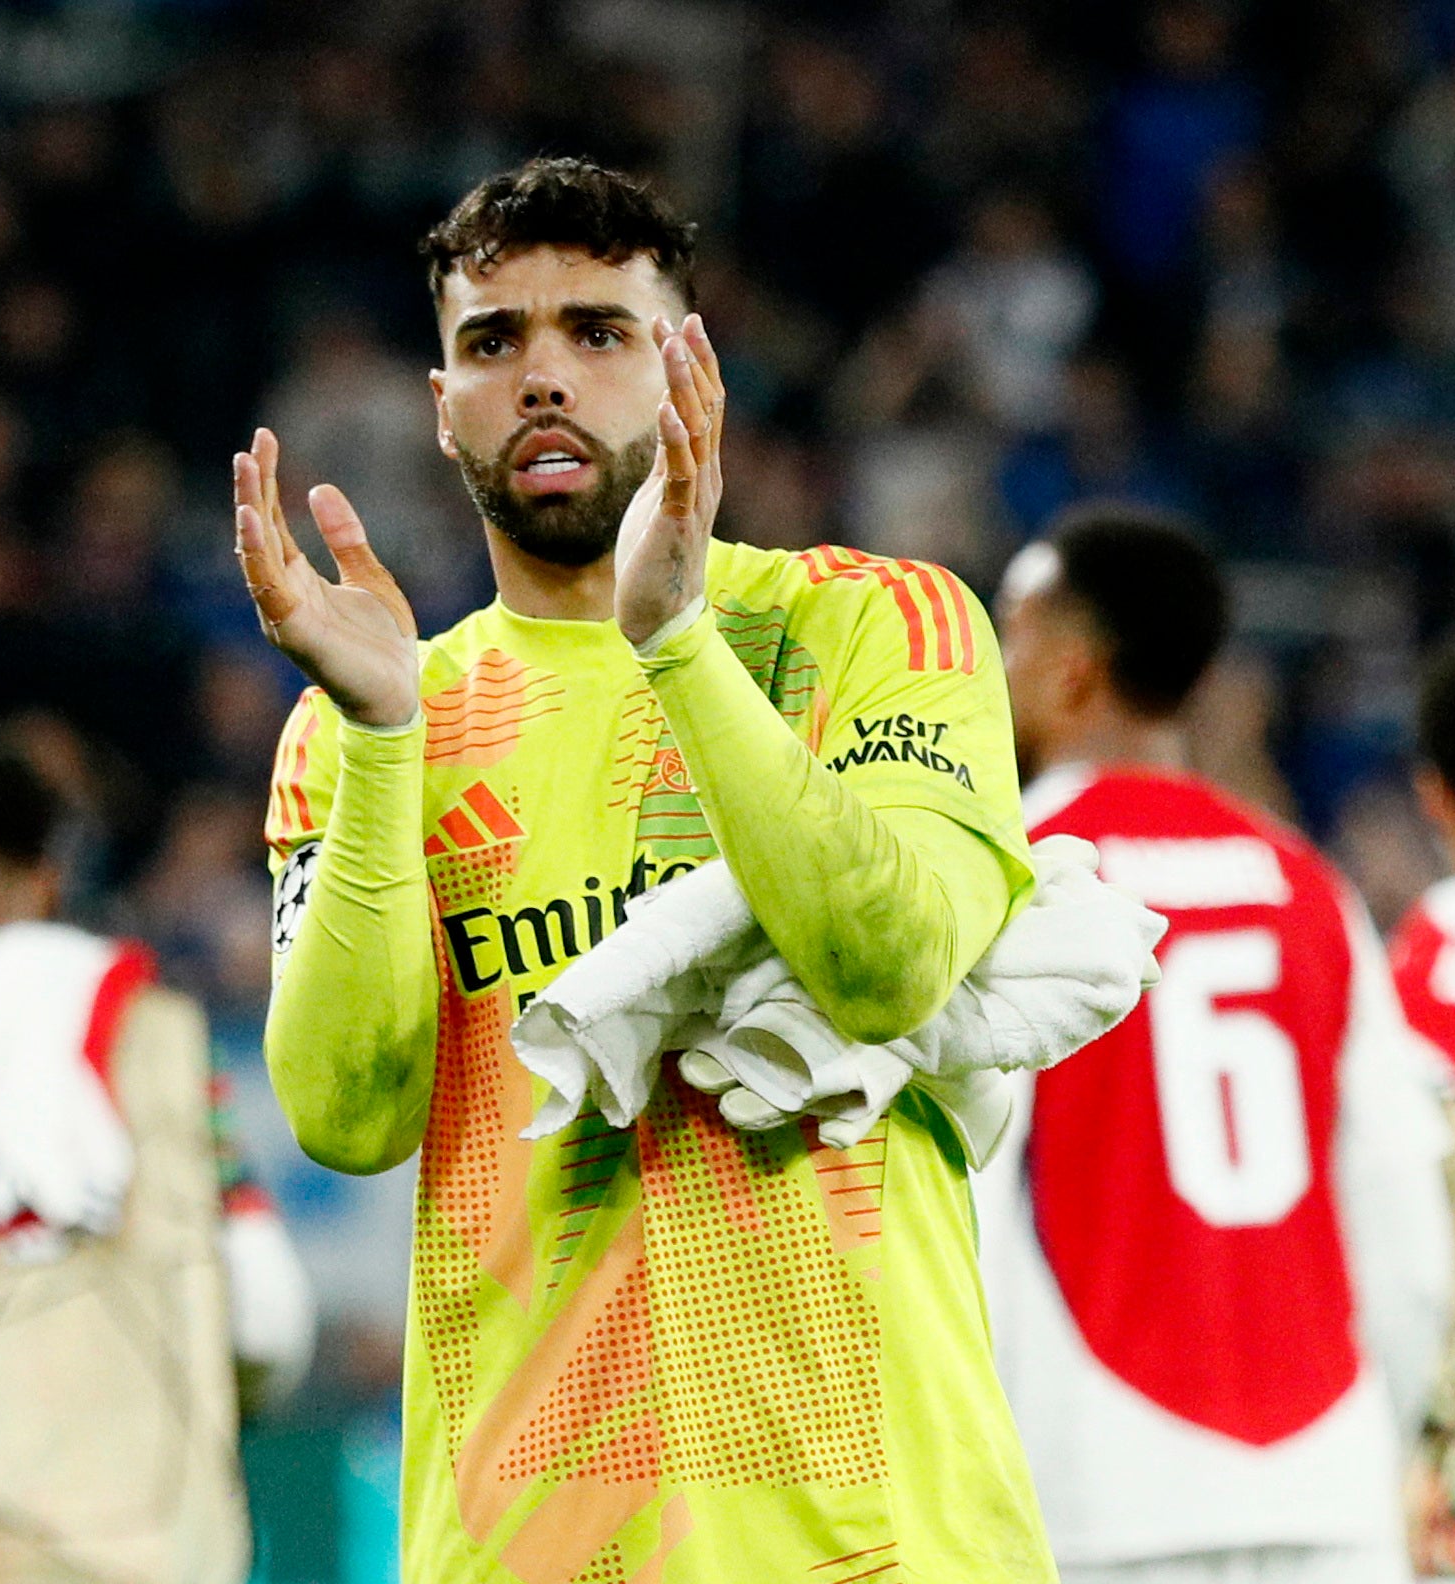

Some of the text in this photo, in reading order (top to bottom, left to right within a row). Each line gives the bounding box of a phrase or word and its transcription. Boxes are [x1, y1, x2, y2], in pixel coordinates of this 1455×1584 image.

[853, 714, 948, 746] VISIT
[826, 740, 977, 794] WANDA
[1149, 926, 1313, 1228] 6
